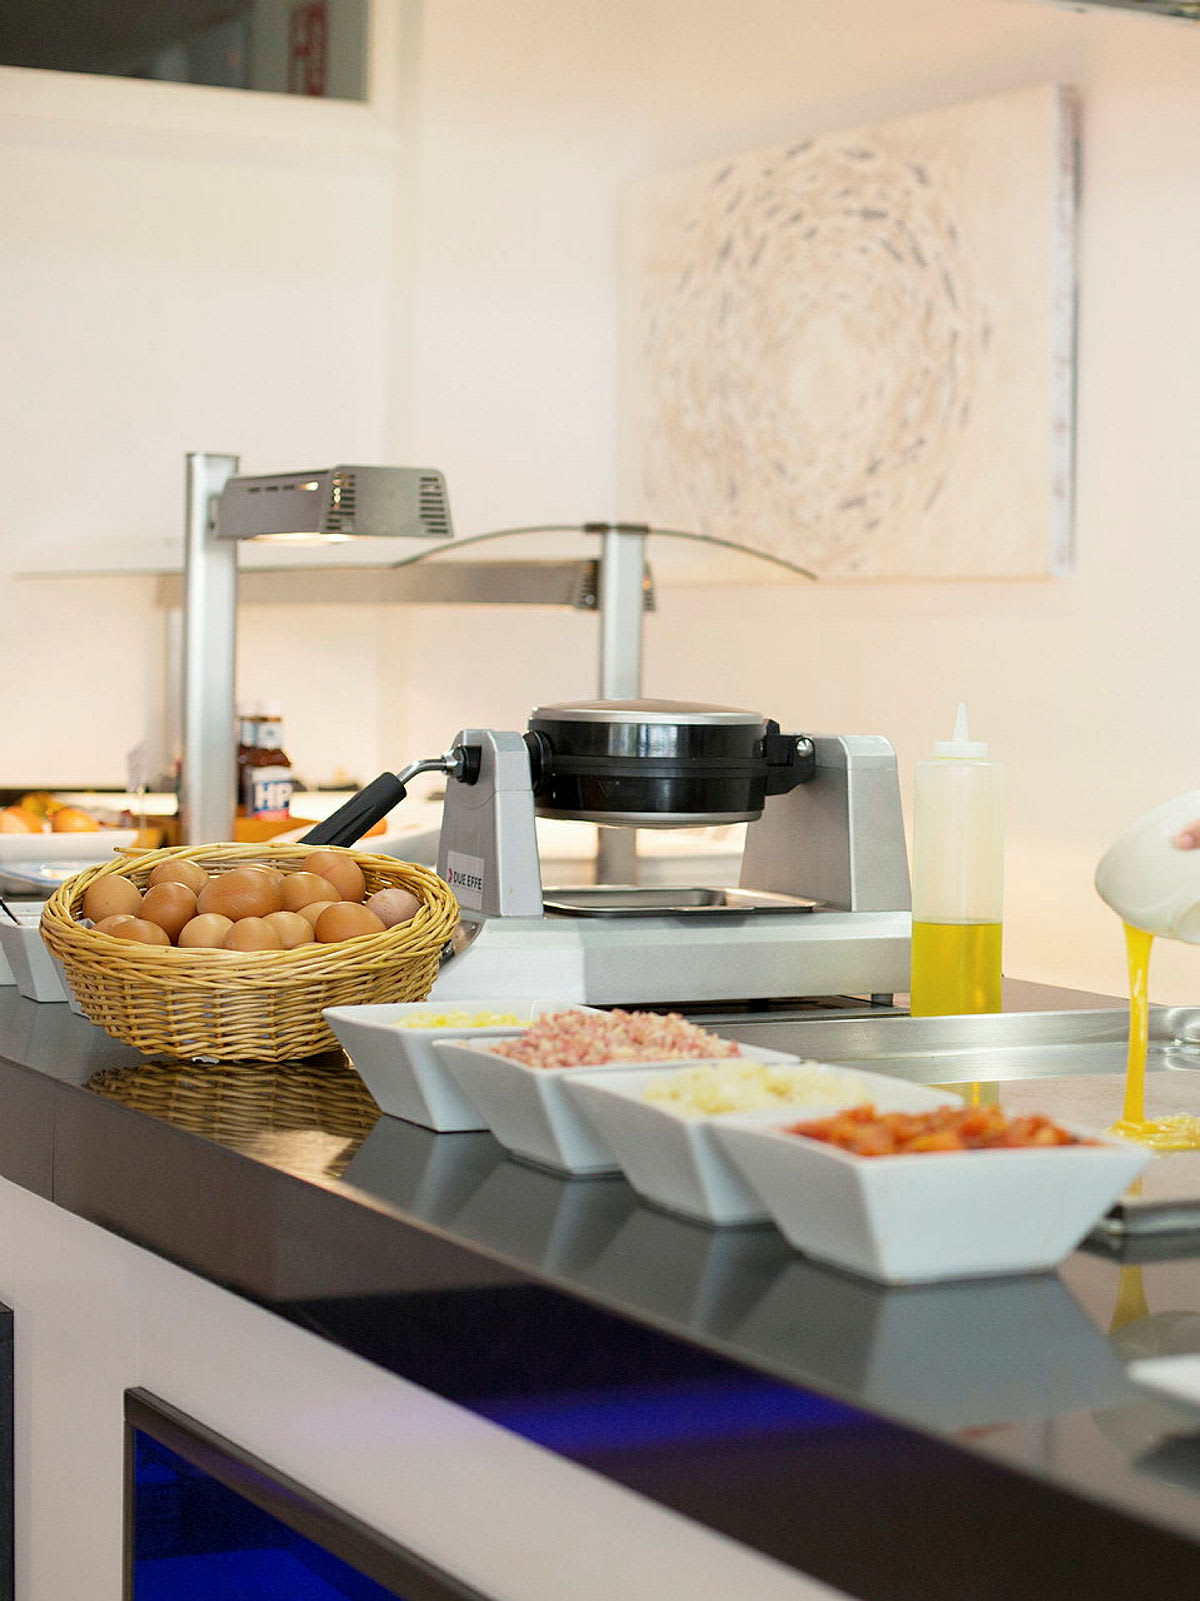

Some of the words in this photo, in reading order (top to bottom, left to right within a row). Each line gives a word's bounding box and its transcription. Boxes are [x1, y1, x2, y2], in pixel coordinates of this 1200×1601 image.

[255, 782, 290, 809] HP
[453, 871, 466, 886] DUE
[467, 875, 482, 890] EFFE
